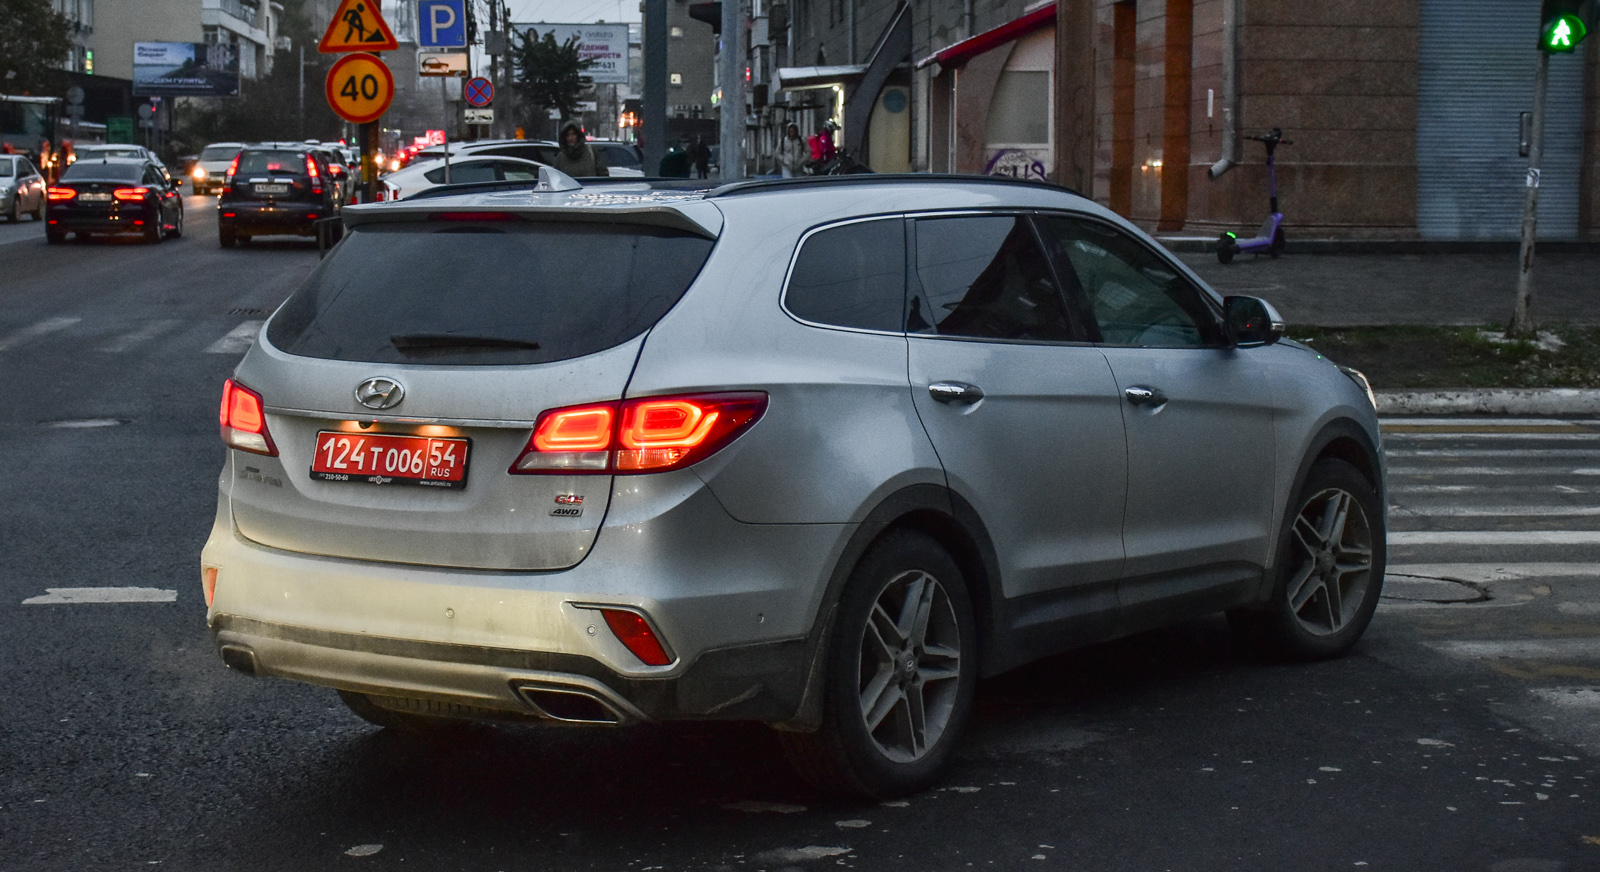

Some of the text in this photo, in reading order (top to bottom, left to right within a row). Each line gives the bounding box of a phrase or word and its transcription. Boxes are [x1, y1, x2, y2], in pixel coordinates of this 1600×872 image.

[430, 5, 456, 43] P
[340, 74, 378, 101] 40
[429, 442, 456, 467] 54
[325, 473, 349, 481] 210-50-60
[431, 467, 450, 477] RUS
